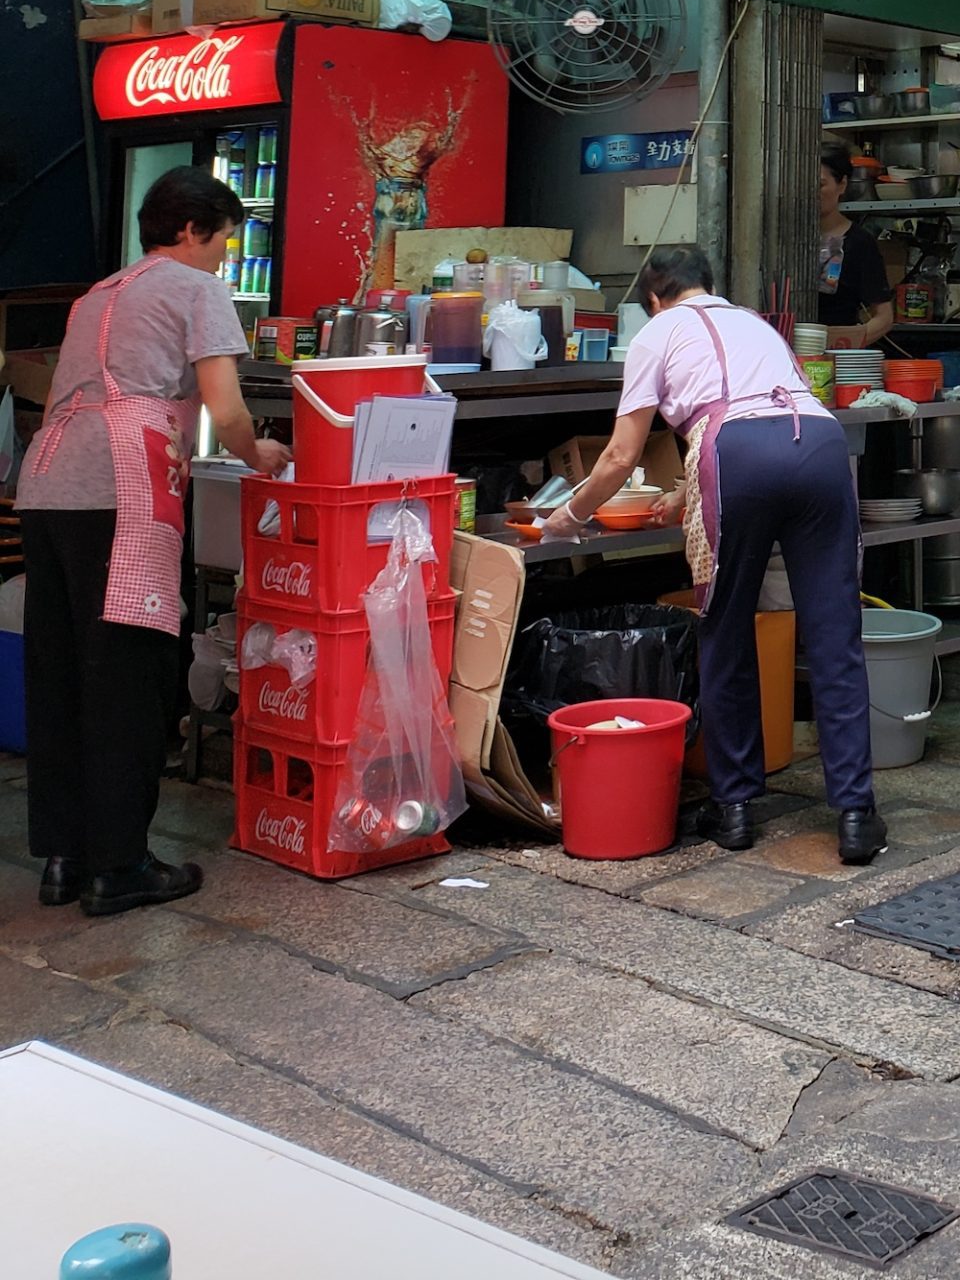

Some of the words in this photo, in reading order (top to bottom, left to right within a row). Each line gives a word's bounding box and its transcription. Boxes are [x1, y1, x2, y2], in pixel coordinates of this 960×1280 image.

[125, 34, 245, 107] Coca-Cola
[262, 558, 312, 598] Coca-Cola
[259, 681, 311, 721] Coca-Cola
[255, 807, 307, 856] Coca-Cola
